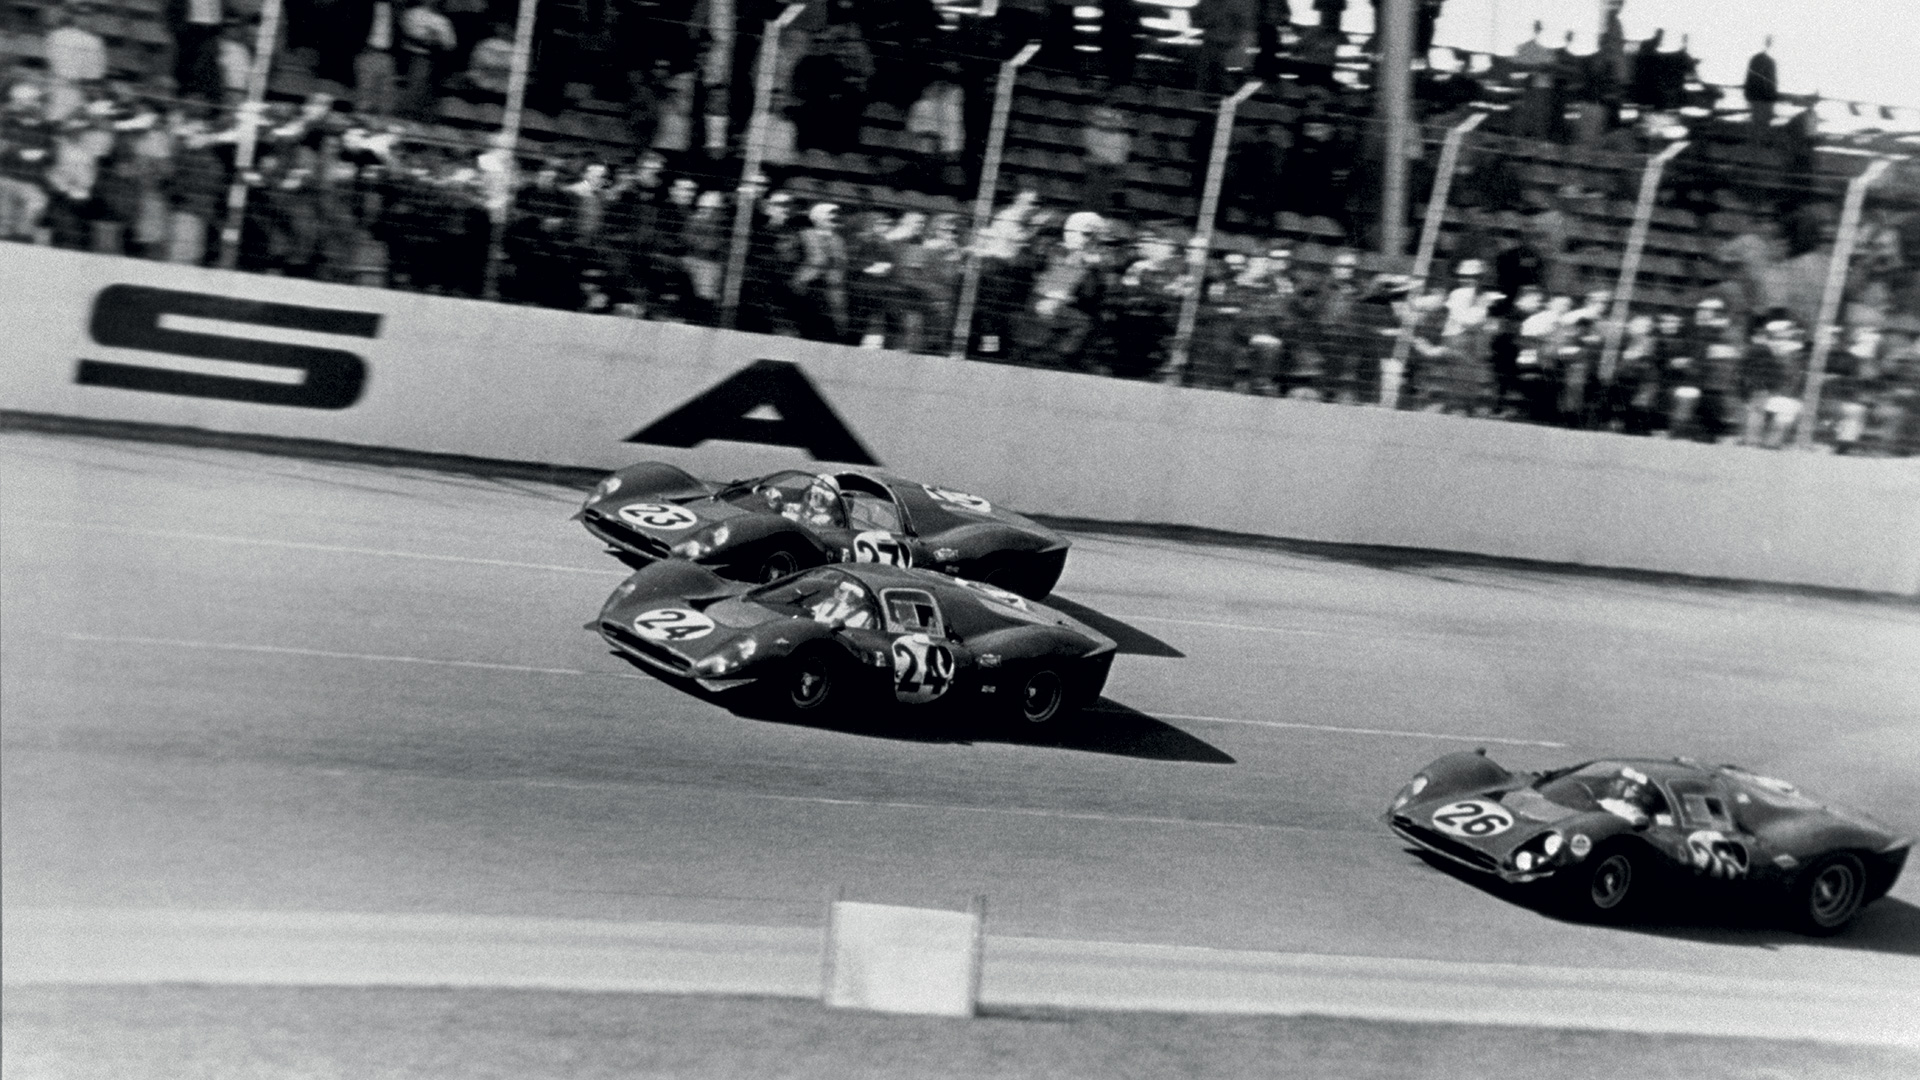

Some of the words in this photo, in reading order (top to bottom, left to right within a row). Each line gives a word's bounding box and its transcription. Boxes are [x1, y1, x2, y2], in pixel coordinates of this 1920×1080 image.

[623, 504, 693, 526] 23
[636, 611, 712, 640] 24
[894, 643, 947, 695] 24
[1434, 803, 1509, 835] 26
